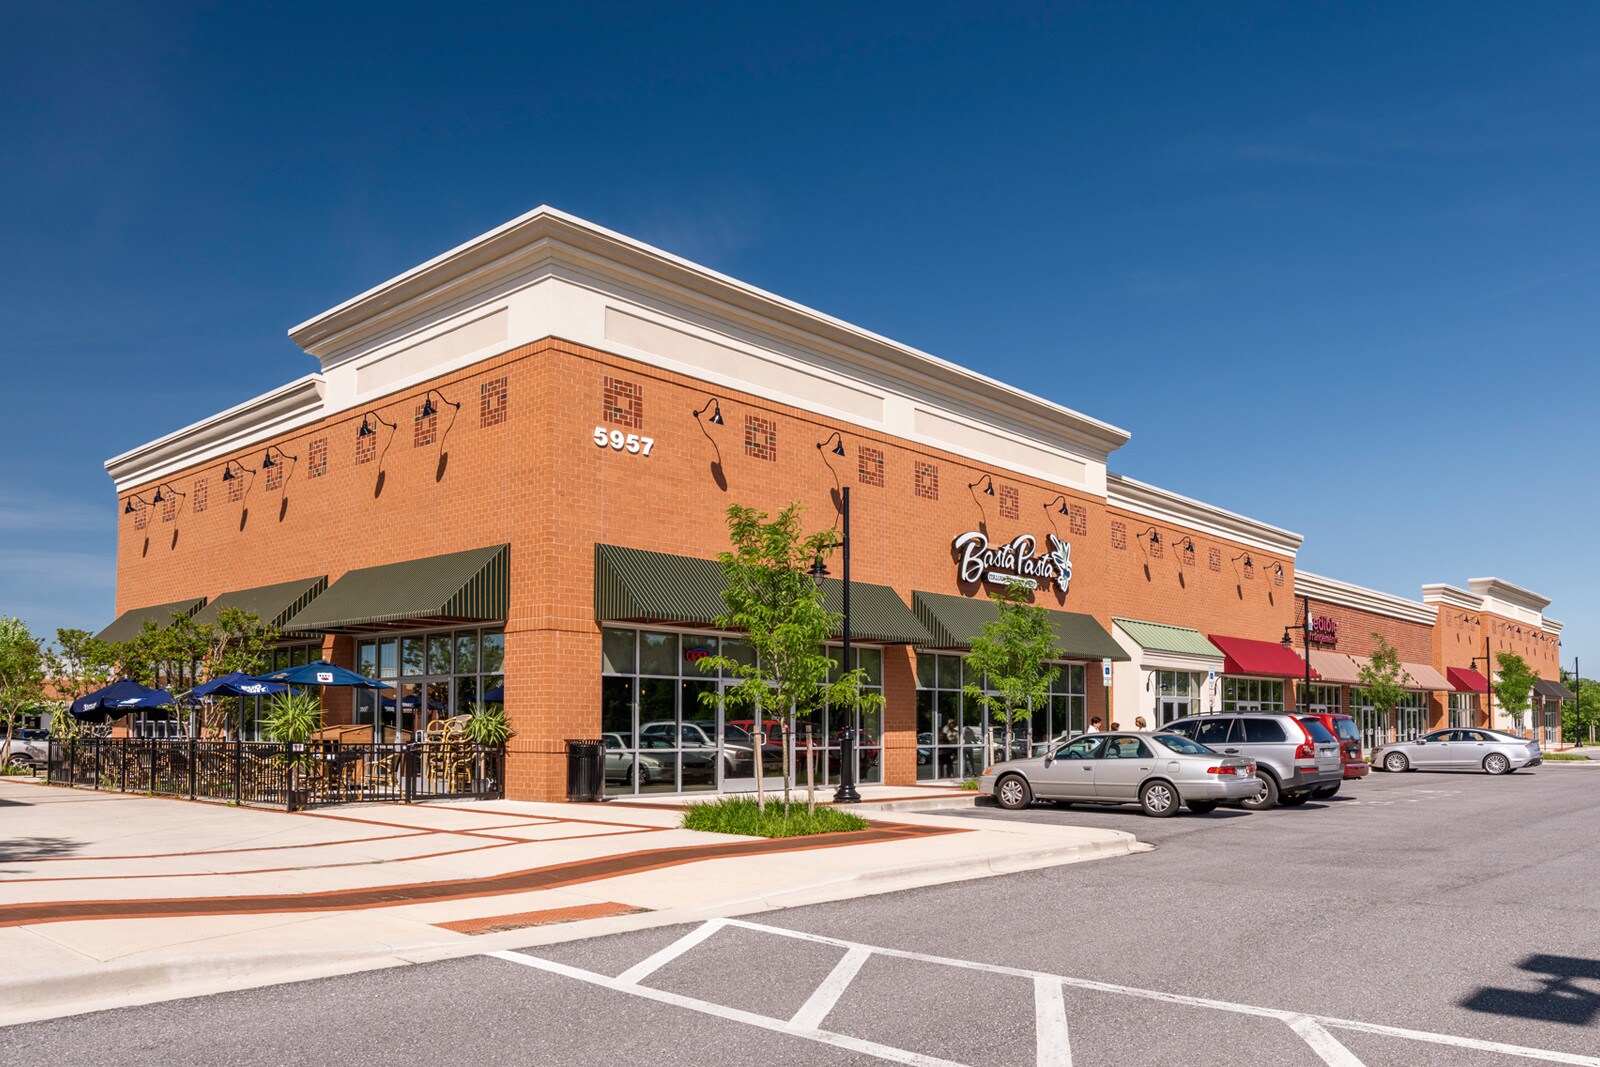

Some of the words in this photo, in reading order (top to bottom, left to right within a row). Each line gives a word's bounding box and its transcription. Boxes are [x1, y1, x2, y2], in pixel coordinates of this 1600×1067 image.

[593, 426, 654, 456] 5957
[955, 531, 1015, 583] Basta
[1012, 534, 1054, 577] Pasta
